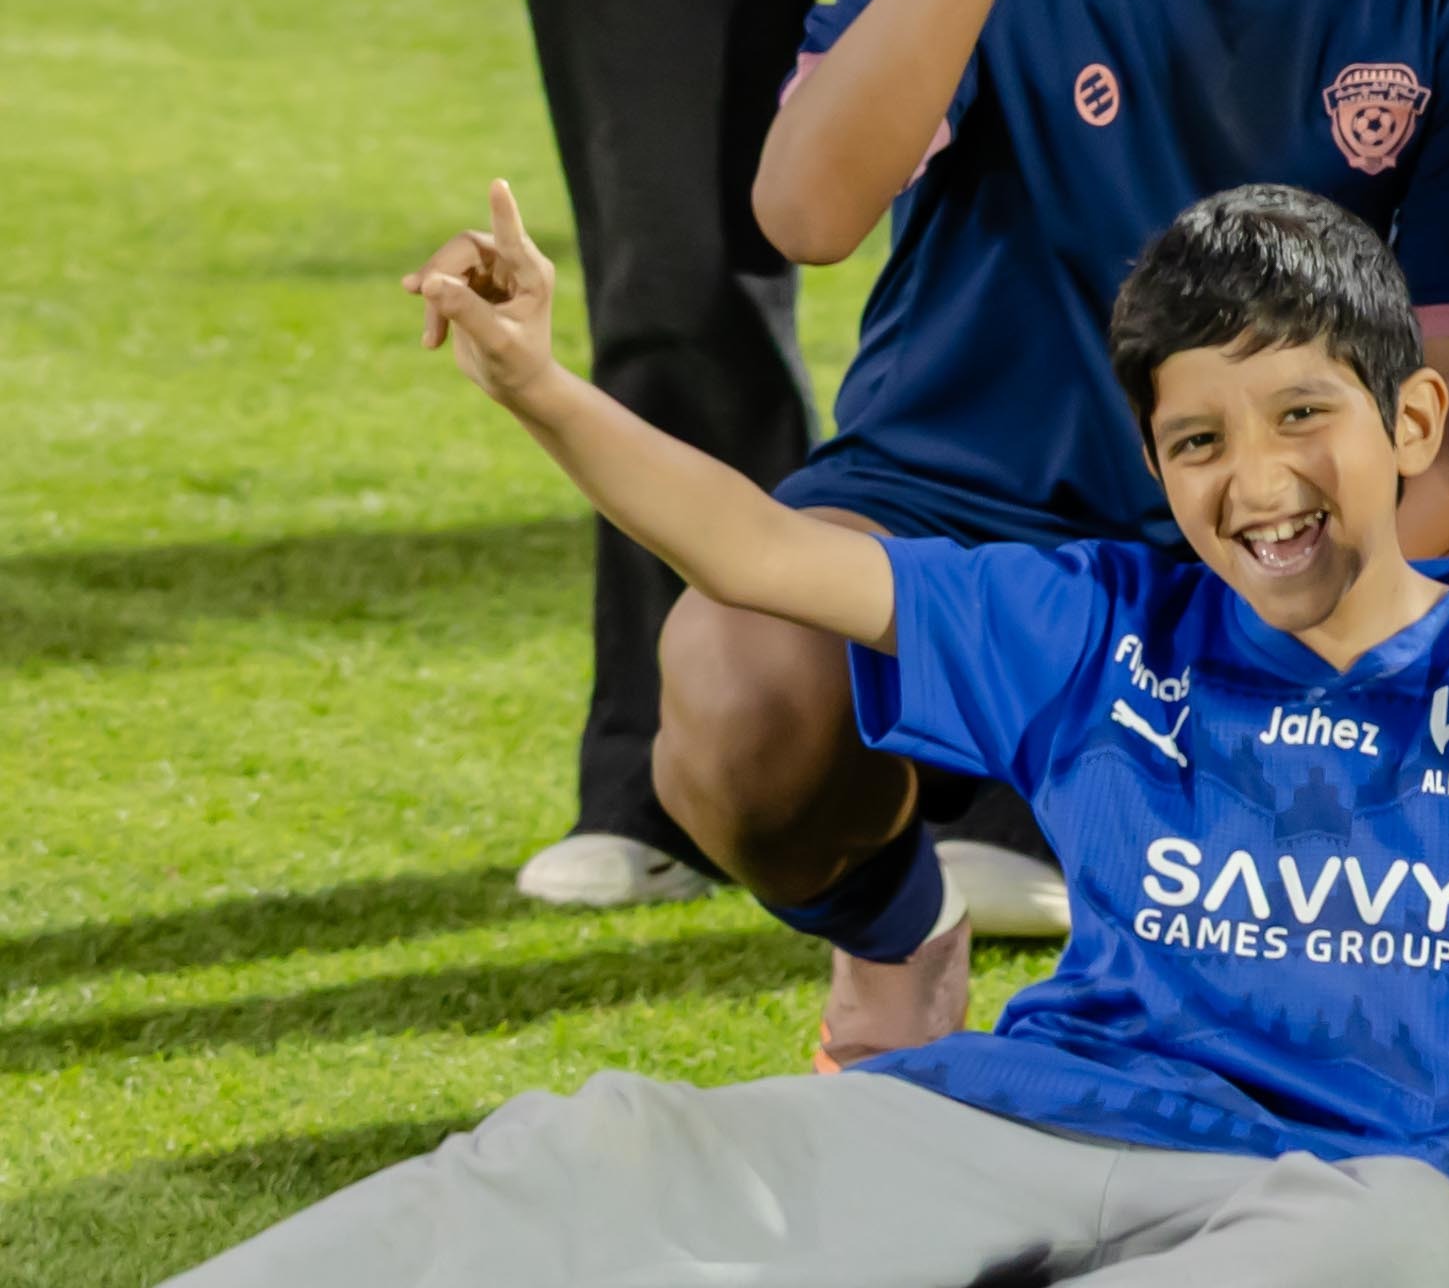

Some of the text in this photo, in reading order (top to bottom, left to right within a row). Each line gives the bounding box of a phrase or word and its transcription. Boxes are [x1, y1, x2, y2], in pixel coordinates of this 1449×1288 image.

[1259, 705, 1380, 757] Jahez
[1421, 769, 1446, 794] AL
[1133, 908, 1289, 960] GAMES
